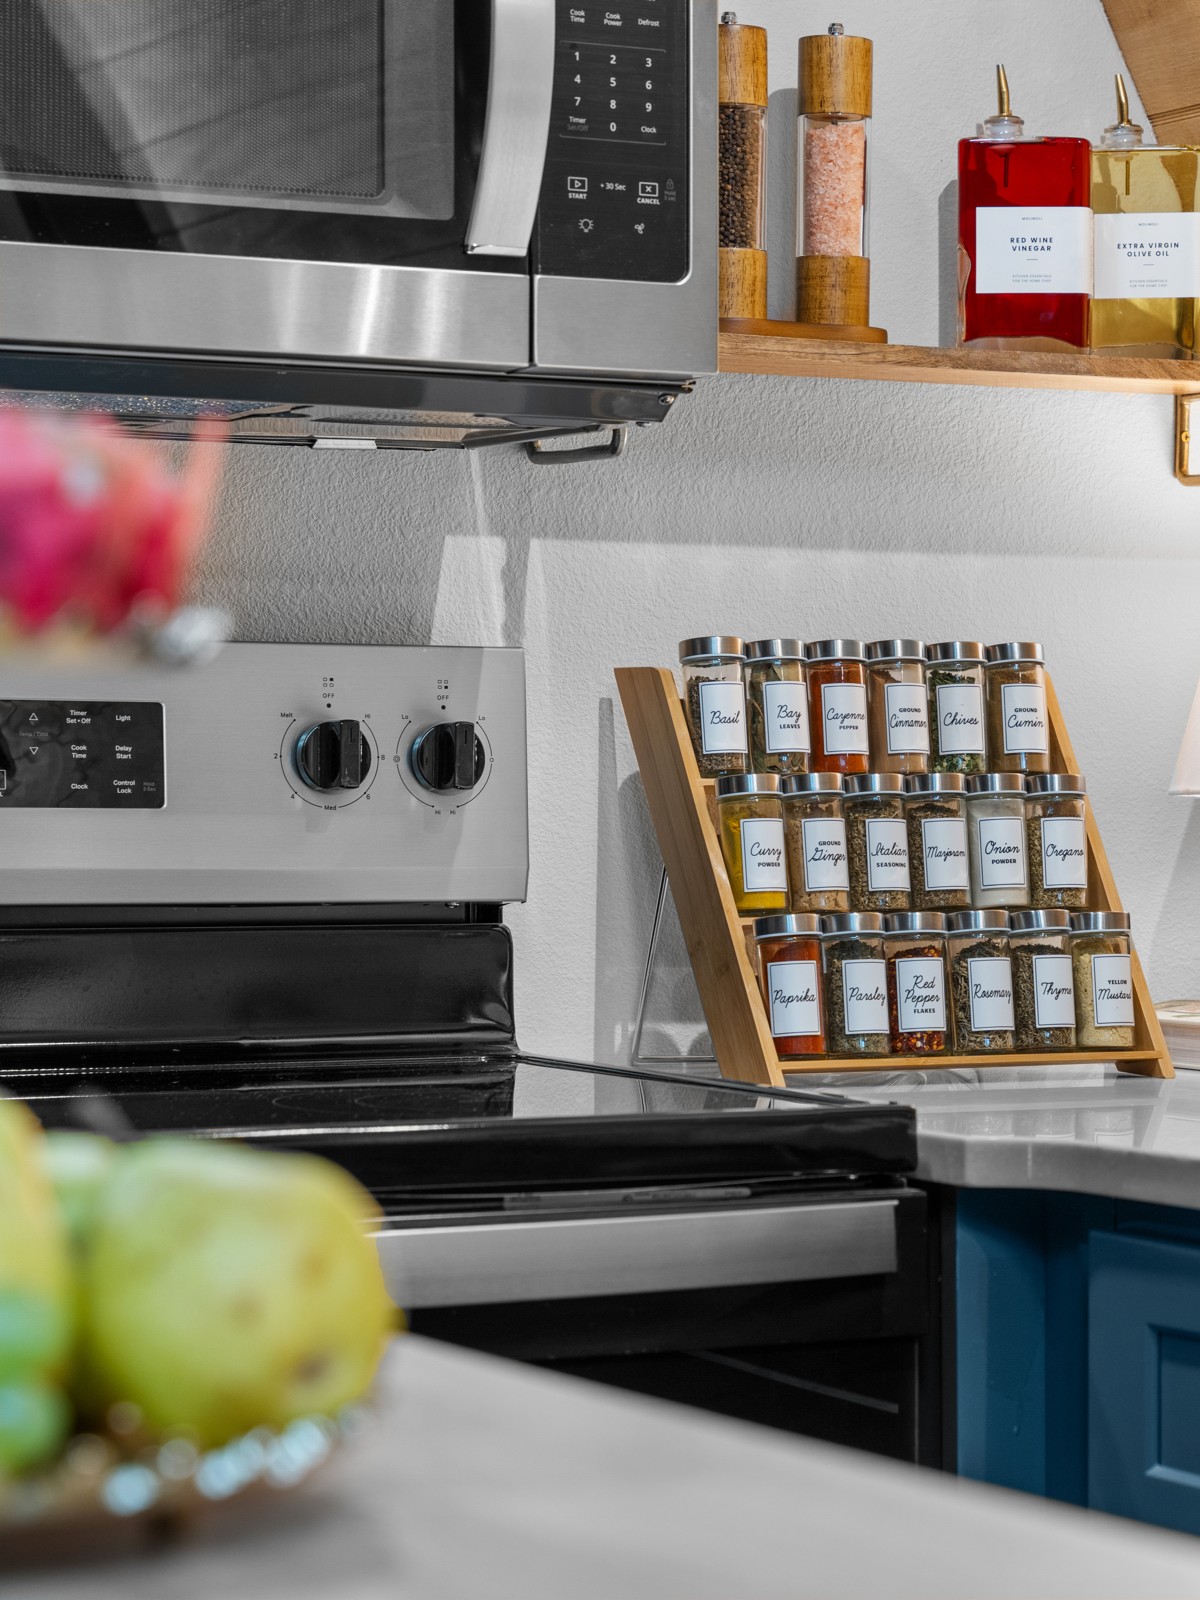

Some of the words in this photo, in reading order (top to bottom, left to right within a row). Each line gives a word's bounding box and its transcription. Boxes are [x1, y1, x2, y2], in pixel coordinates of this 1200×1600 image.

[570, 8, 586, 16] Cook
[605, 12, 621, 20] Cook
[570, 16, 586, 24] Time
[604, 18, 622, 26] Power
[638, 18, 660, 27] Defrost
[574, 52, 580, 61] 1
[610, 54, 616, 64] 2
[645, 58, 652, 68] 3
[574, 74, 581, 84] 4
[610, 77, 616, 87] 5
[645, 80, 652, 90] 6
[574, 96, 581, 106] 7
[610, 100, 616, 110] 8
[645, 102, 652, 112] 9
[568, 116, 587, 124] Timer
[610, 122, 616, 132] 0
[640, 126, 657, 134] Clock
[636, 197, 660, 205] CANCEL
[777, 704, 802, 719] Bay
[710, 710, 740, 725] Basil
[890, 714, 927, 728] Cinnamon
[943, 712, 979, 727] Chives
[1008, 714, 1044, 728] Cumin
[750, 842, 782, 860] Curry
[871, 842, 907, 856] Italian
[984, 840, 1021, 854] Onion
[1045, 844, 1084, 861] Oregano
[808, 848, 846, 866] Ginger
[927, 846, 966, 862] Marjoram
[913, 975, 936, 989] Red
[849, 986, 886, 1006] Parsley
[973, 984, 1012, 1004] Rosemary
[1040, 982, 1072, 1000] Thyme
[1098, 988, 1132, 1000] Mustard
[774, 988, 816, 1008] Paprika
[904, 989, 941, 1007] Pepper
